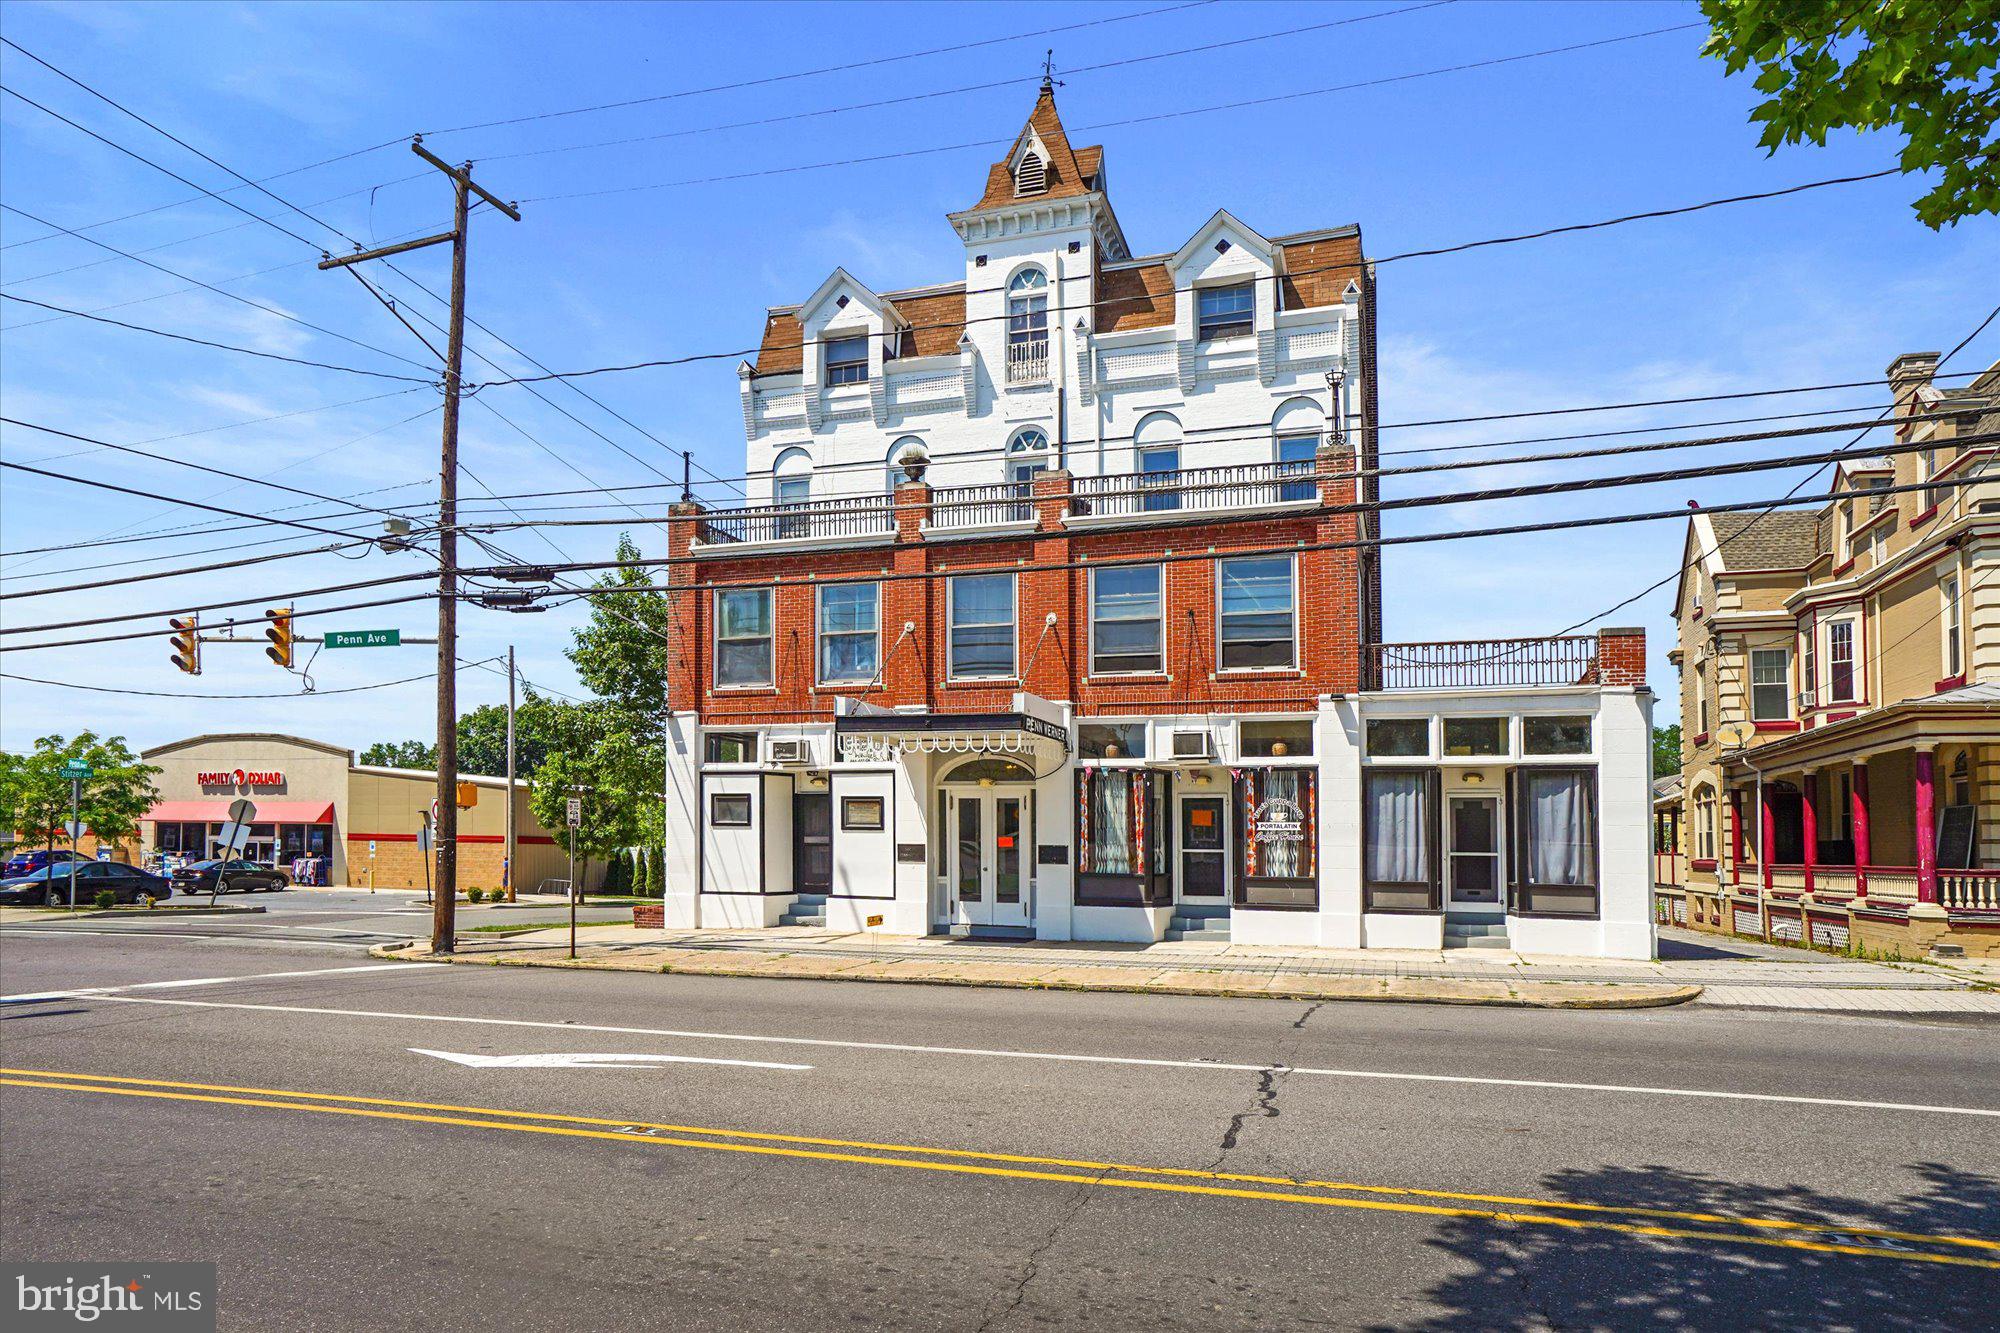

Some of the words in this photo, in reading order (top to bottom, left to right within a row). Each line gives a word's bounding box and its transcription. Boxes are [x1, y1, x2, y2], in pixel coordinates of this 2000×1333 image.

[336, 635, 364, 645] Penn
[367, 634, 387, 644] Ave
[1026, 717, 1043, 734] PENN
[197, 772, 230, 785] FAMILY
[248, 772, 281, 785] DOLLAR
